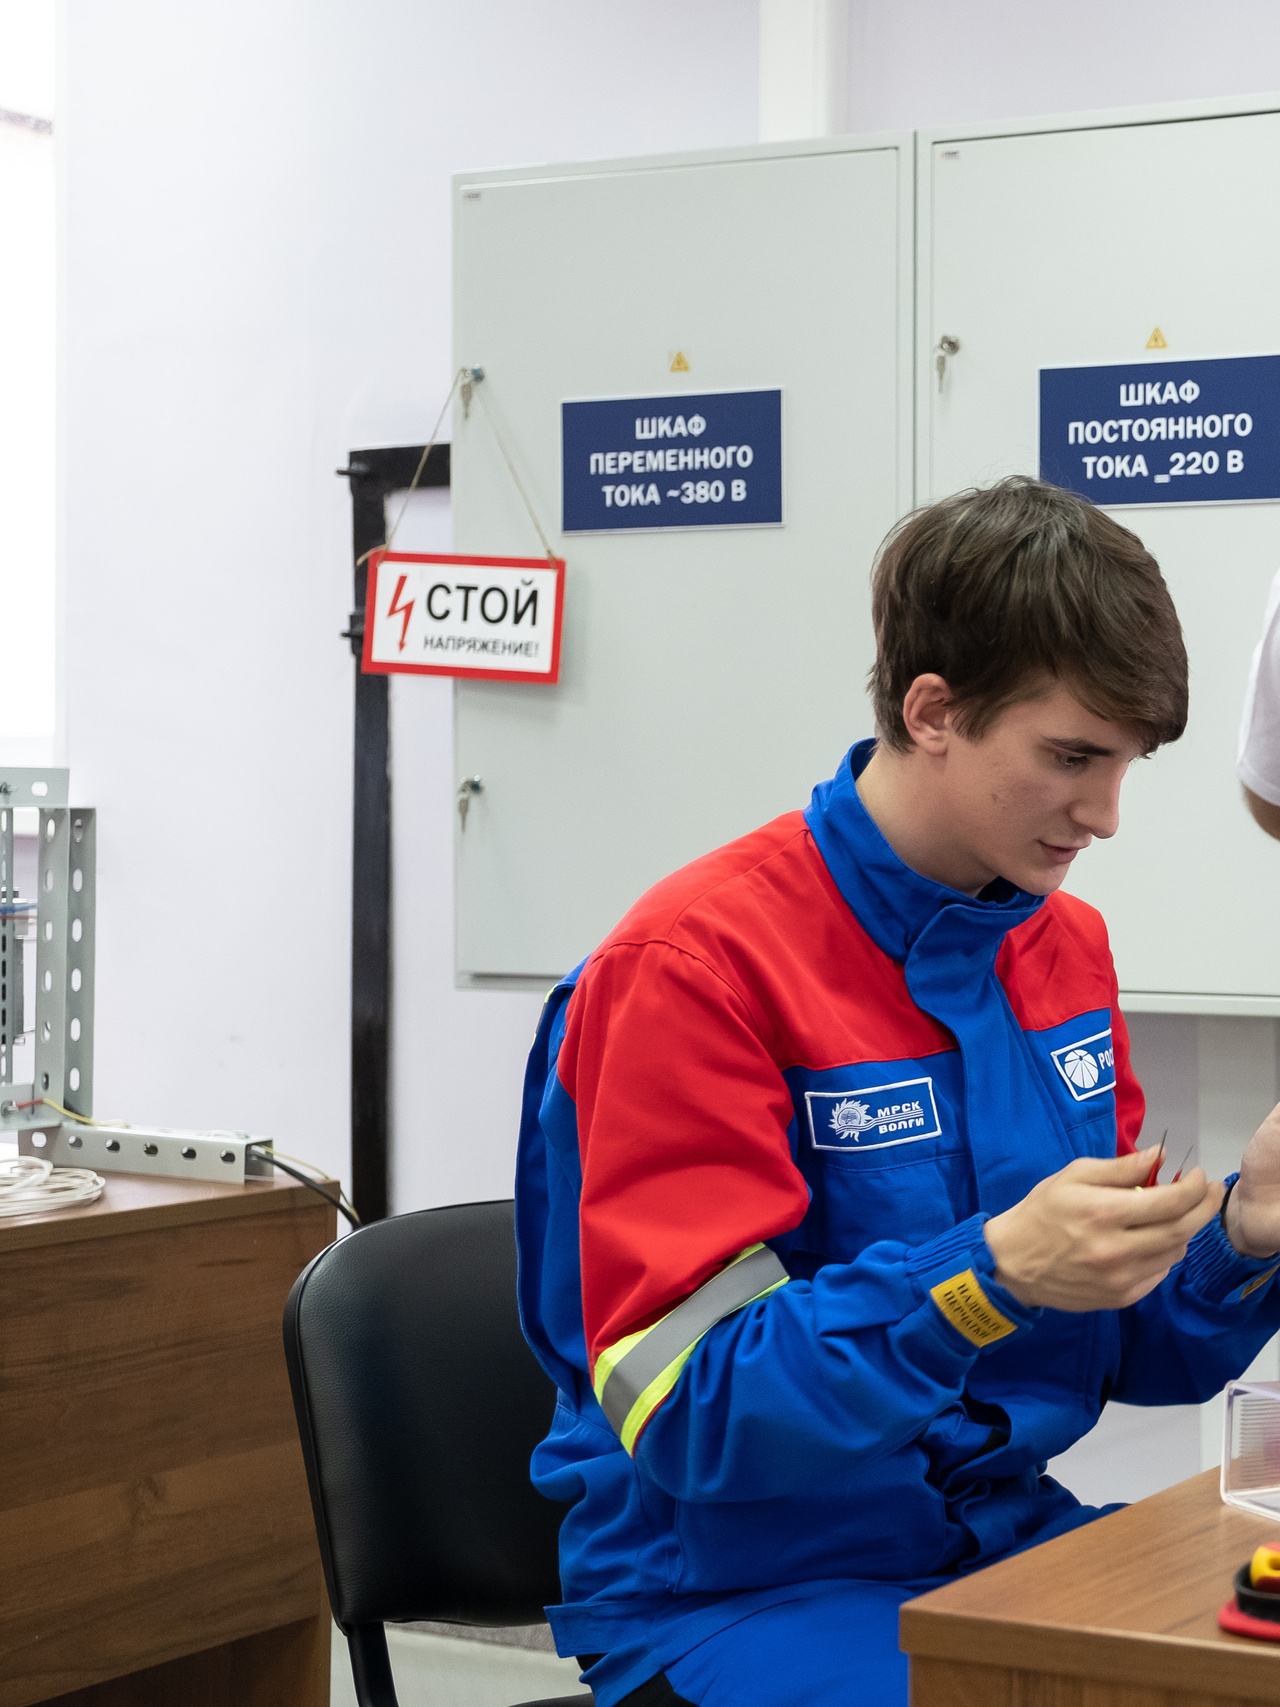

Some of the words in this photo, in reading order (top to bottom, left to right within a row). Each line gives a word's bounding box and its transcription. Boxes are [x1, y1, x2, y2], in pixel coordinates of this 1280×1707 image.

[1119, 379, 1201, 407] ШКАФ
[635, 413, 707, 440] ШКАФ
[1068, 412, 1253, 445] ПОСТОЯННОГО
[589, 444, 754, 476] ПЕРЕМЕННОГО
[1081, 454, 1149, 480] ТОКА
[1226, 449, 1244, 474] В
[601, 483, 661, 508] ТОКА
[666, 479, 726, 504] ~380
[731, 478, 747, 502] В
[426, 579, 539, 626] СТОЙ
[424, 635, 540, 658] НАПРЯЖЕНИЕ!
[1097, 1046, 1115, 1070] РОС
[877, 1100, 921, 1118] МРСК
[878, 1117, 924, 1135] ВОЛГИ
